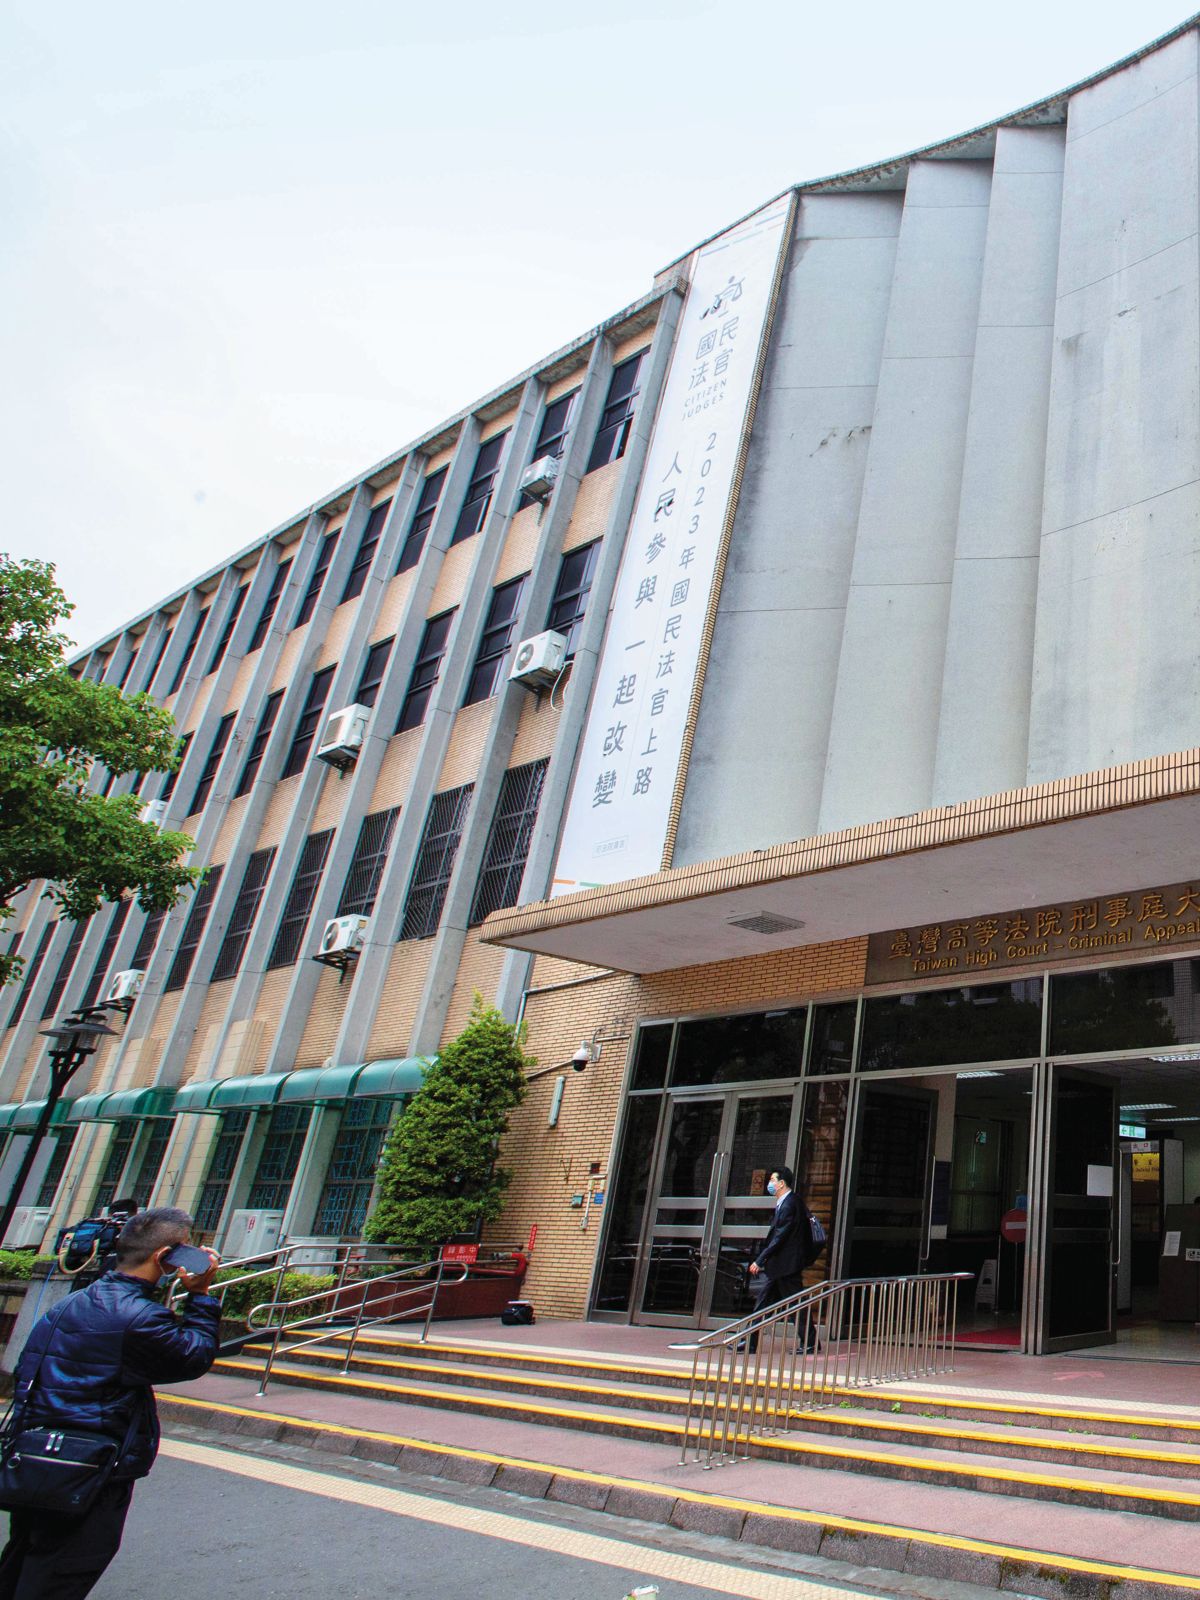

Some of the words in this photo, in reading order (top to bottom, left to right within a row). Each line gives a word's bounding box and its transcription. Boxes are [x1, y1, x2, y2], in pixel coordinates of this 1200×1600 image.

[682, 391, 724, 421] JUDGES
[685, 378, 727, 407] CITIZEN
[912, 956, 957, 972] Taiwan
[965, 948, 997, 966] High
[1007, 941, 1048, 958] Court
[1068, 927, 1132, 950] Criminal
